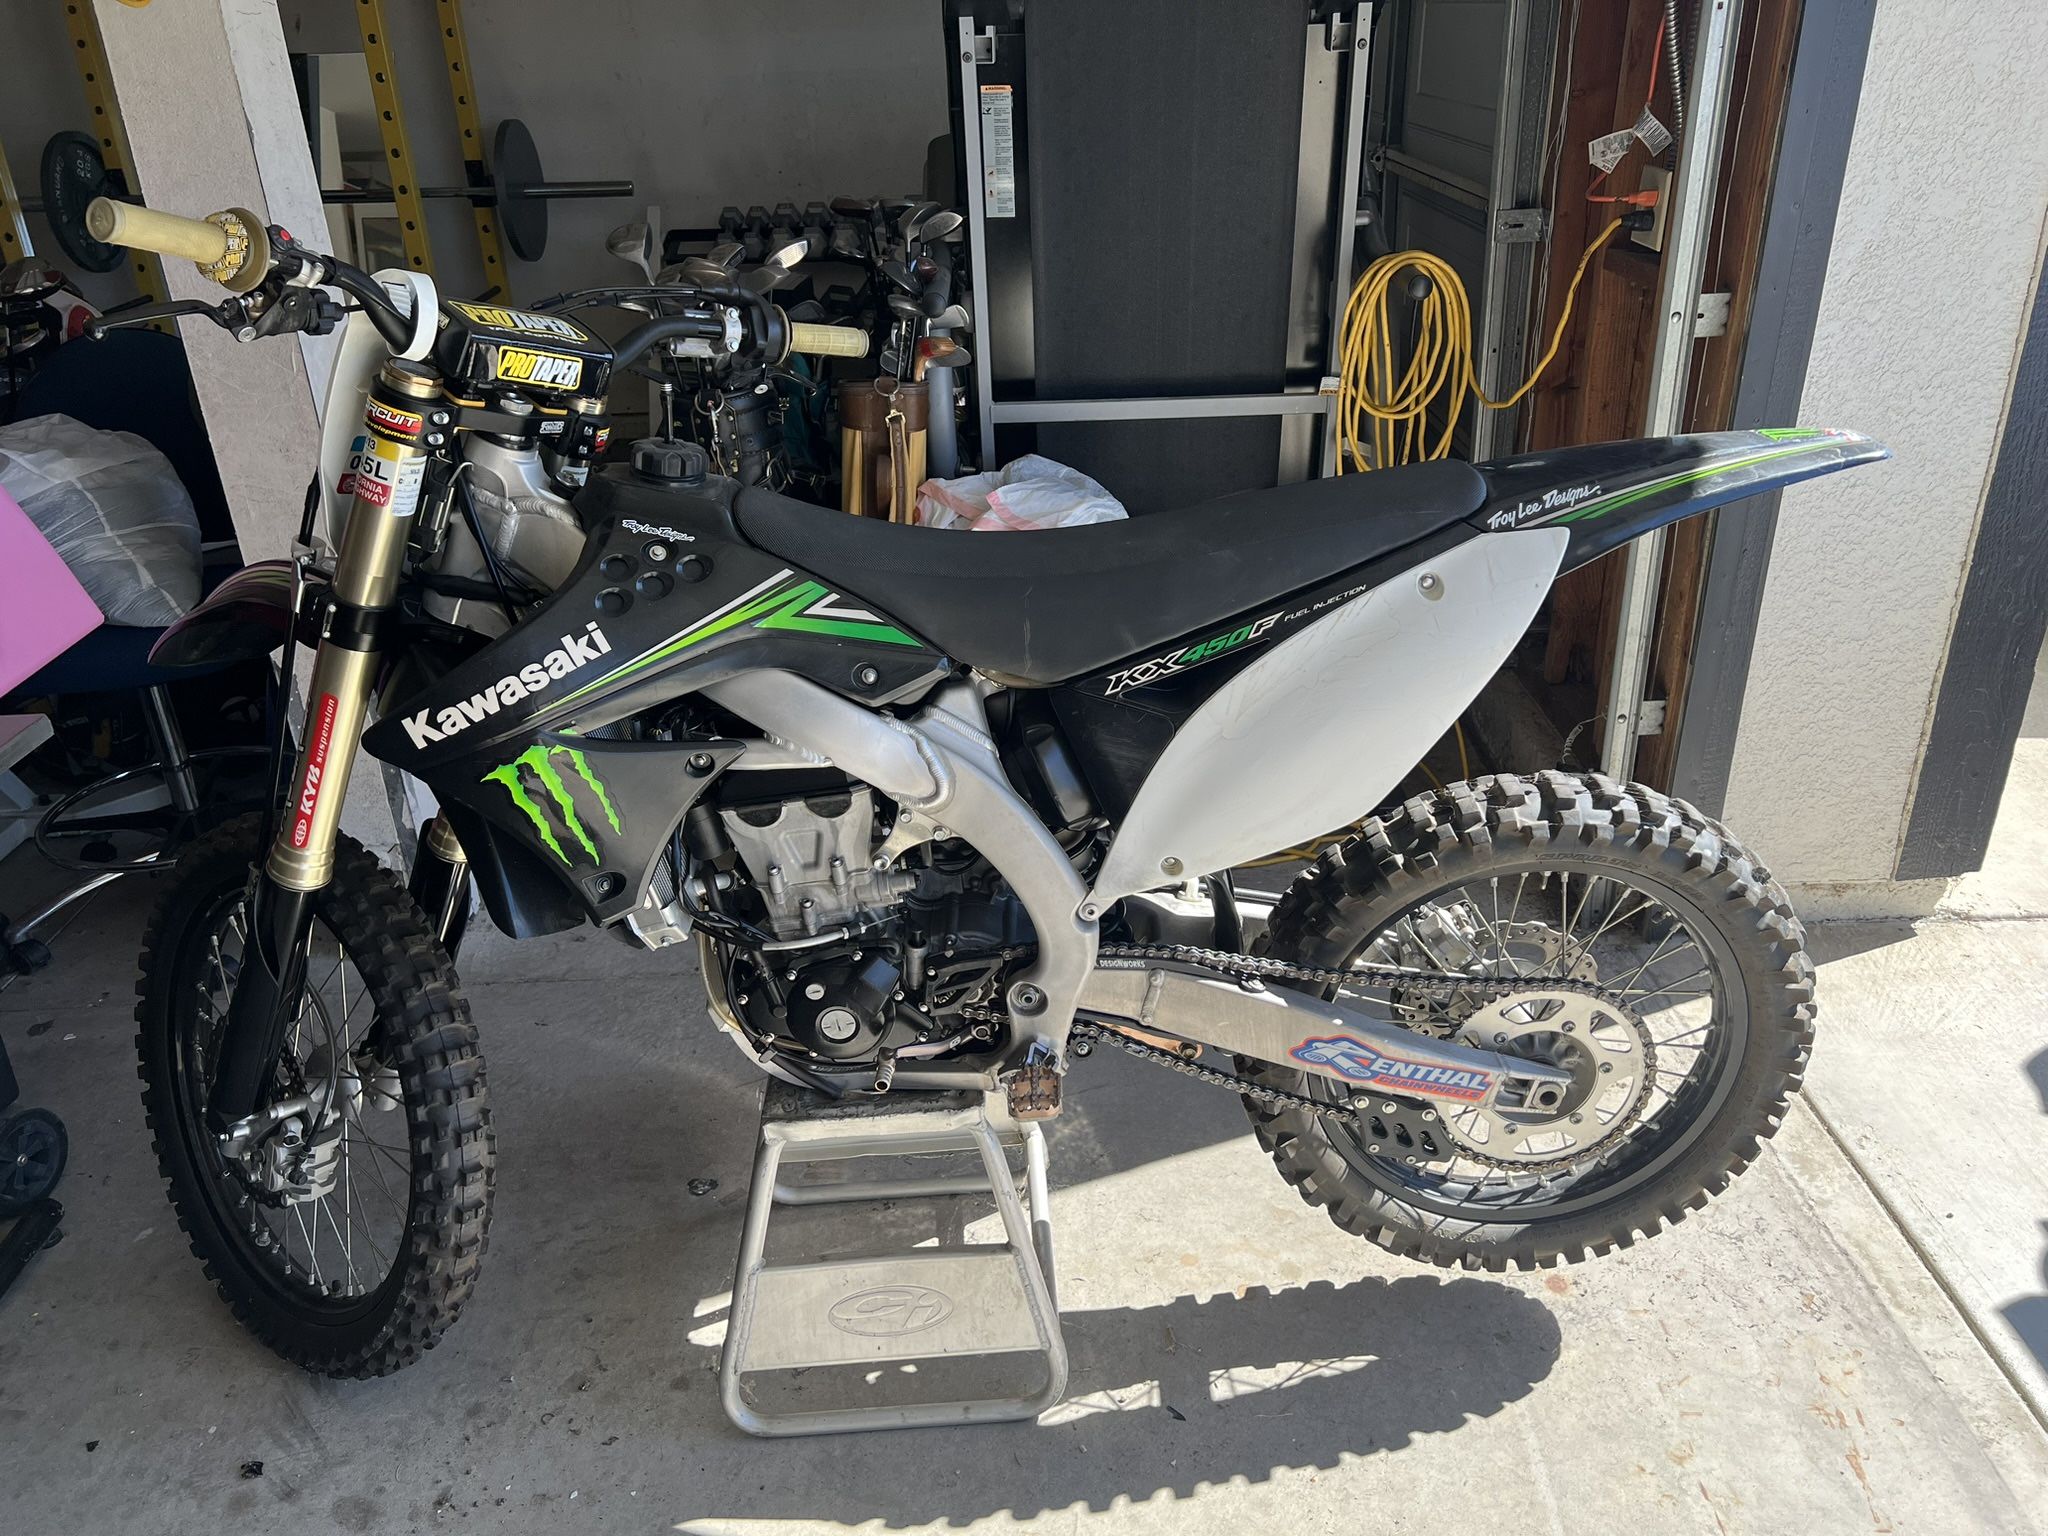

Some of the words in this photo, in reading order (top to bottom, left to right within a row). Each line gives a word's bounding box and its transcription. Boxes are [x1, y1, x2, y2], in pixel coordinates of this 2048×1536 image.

[500, 350, 580, 387] PROTAPER
[365, 398, 419, 428] RCUIT
[1487, 510, 1516, 530] Troy
[1518, 502, 1543, 519] Lee
[1542, 485, 1601, 508] Designs
[1104, 611, 1285, 696] KX450F
[1284, 607, 1311, 622] FUEL
[1312, 584, 1367, 610] INJECTION
[400, 620, 613, 750] Kawasaki
[300, 763, 321, 816] KYB
[316, 698, 335, 763] suspension
[1099, 959, 1146, 968] DESIGNWORKS
[1378, 1074, 1483, 1099] CHAINWHEELS
